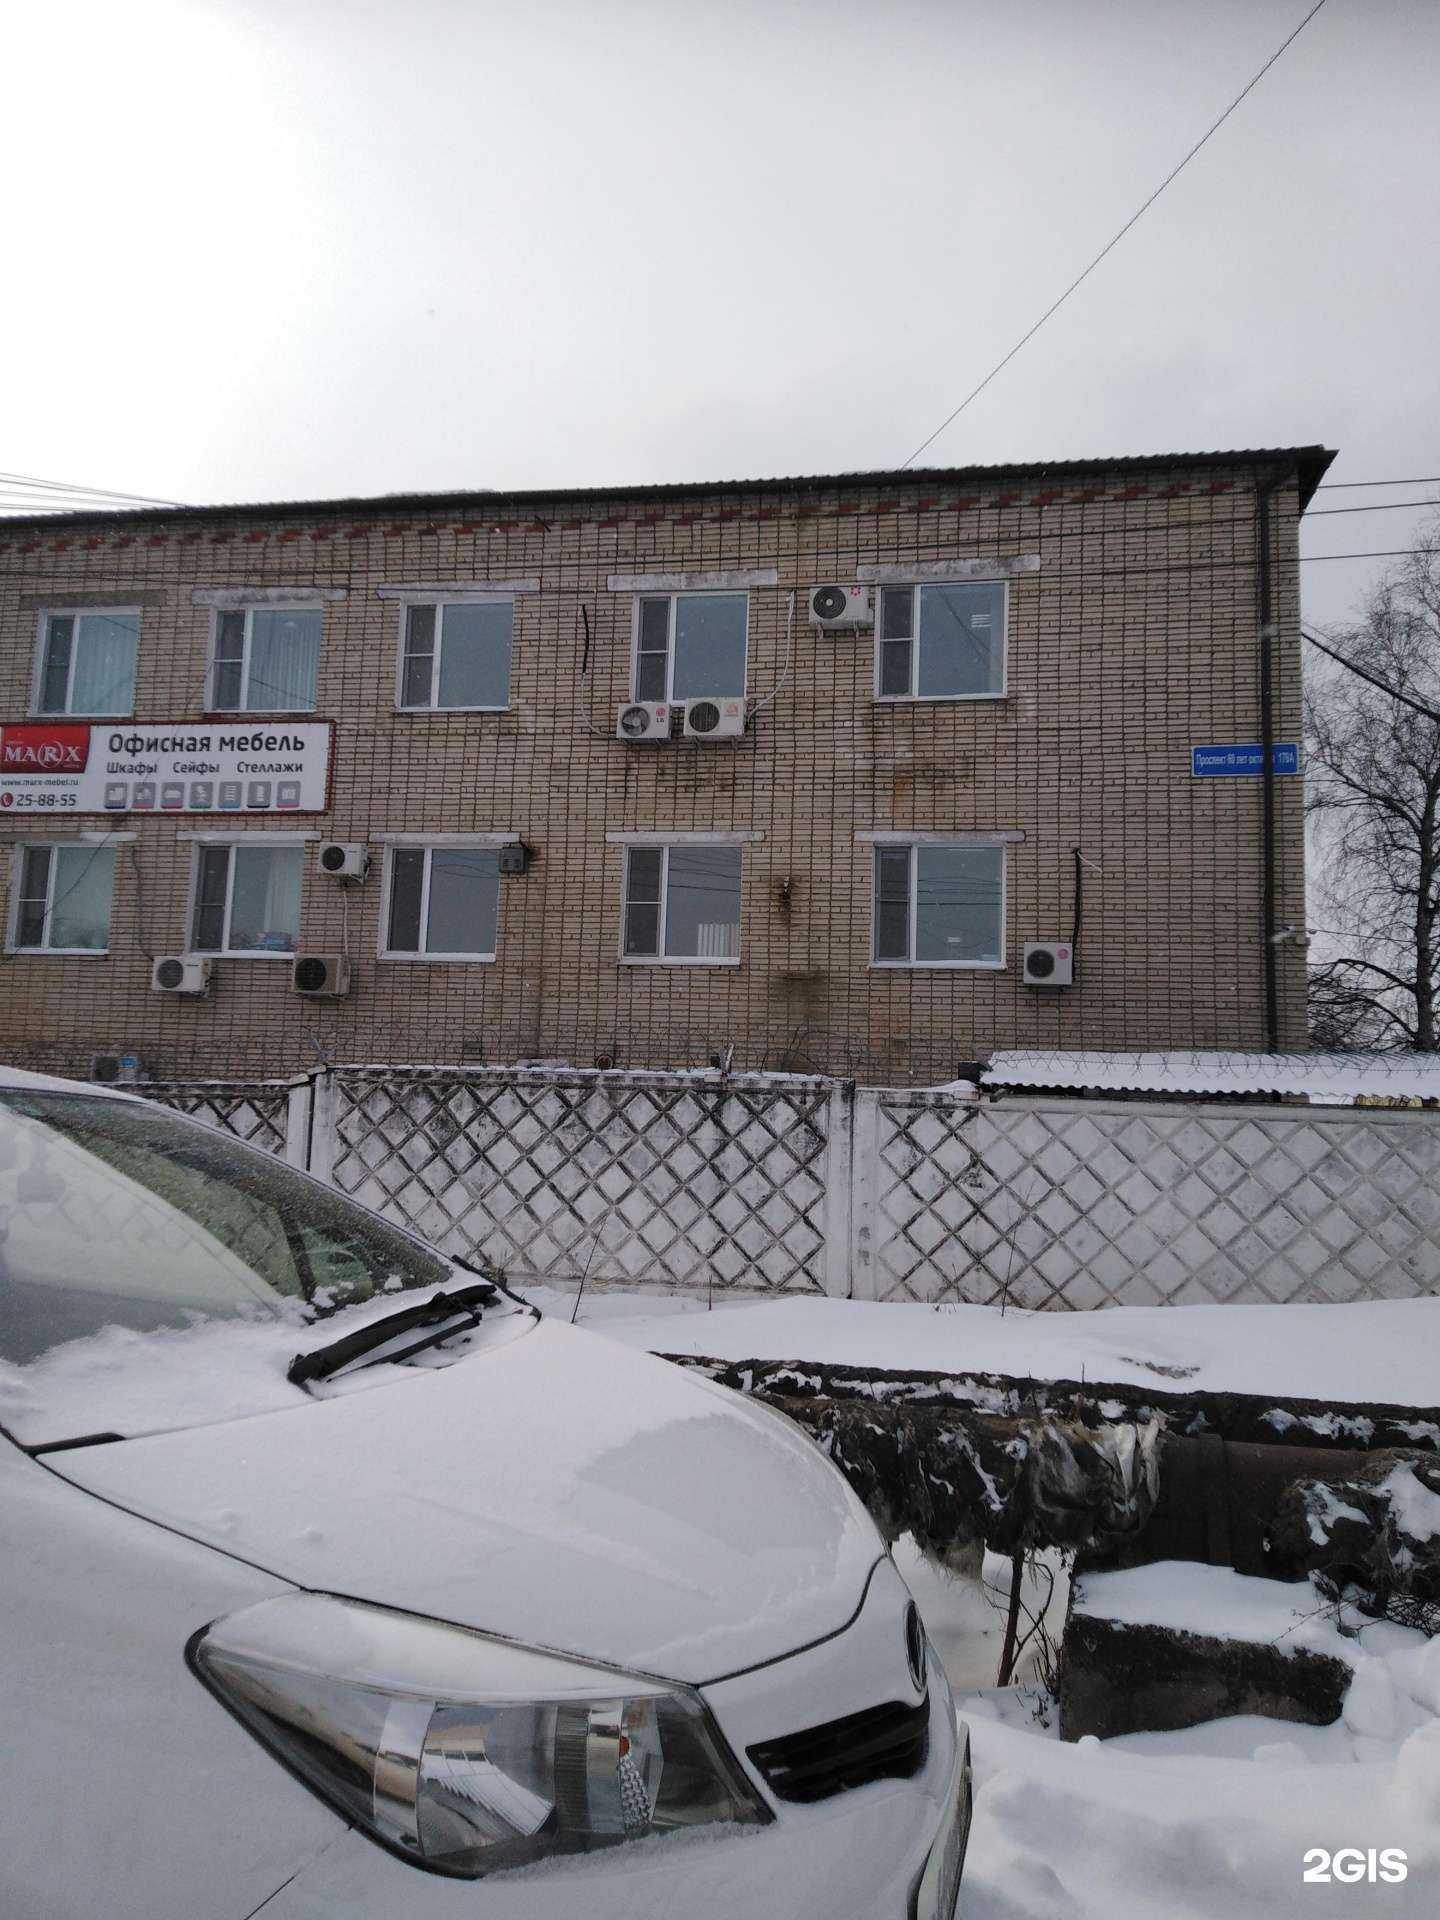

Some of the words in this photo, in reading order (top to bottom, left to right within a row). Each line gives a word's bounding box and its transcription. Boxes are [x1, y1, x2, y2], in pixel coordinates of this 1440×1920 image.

[109, 733, 211, 757] Офисная
[219, 732, 305, 752] мебель
[106, 762, 158, 777] Шкафы
[173, 761, 220, 776] Сейфы
[237, 762, 304, 774] Стеллажи
[16, 793, 77, 807] 25-88-55
